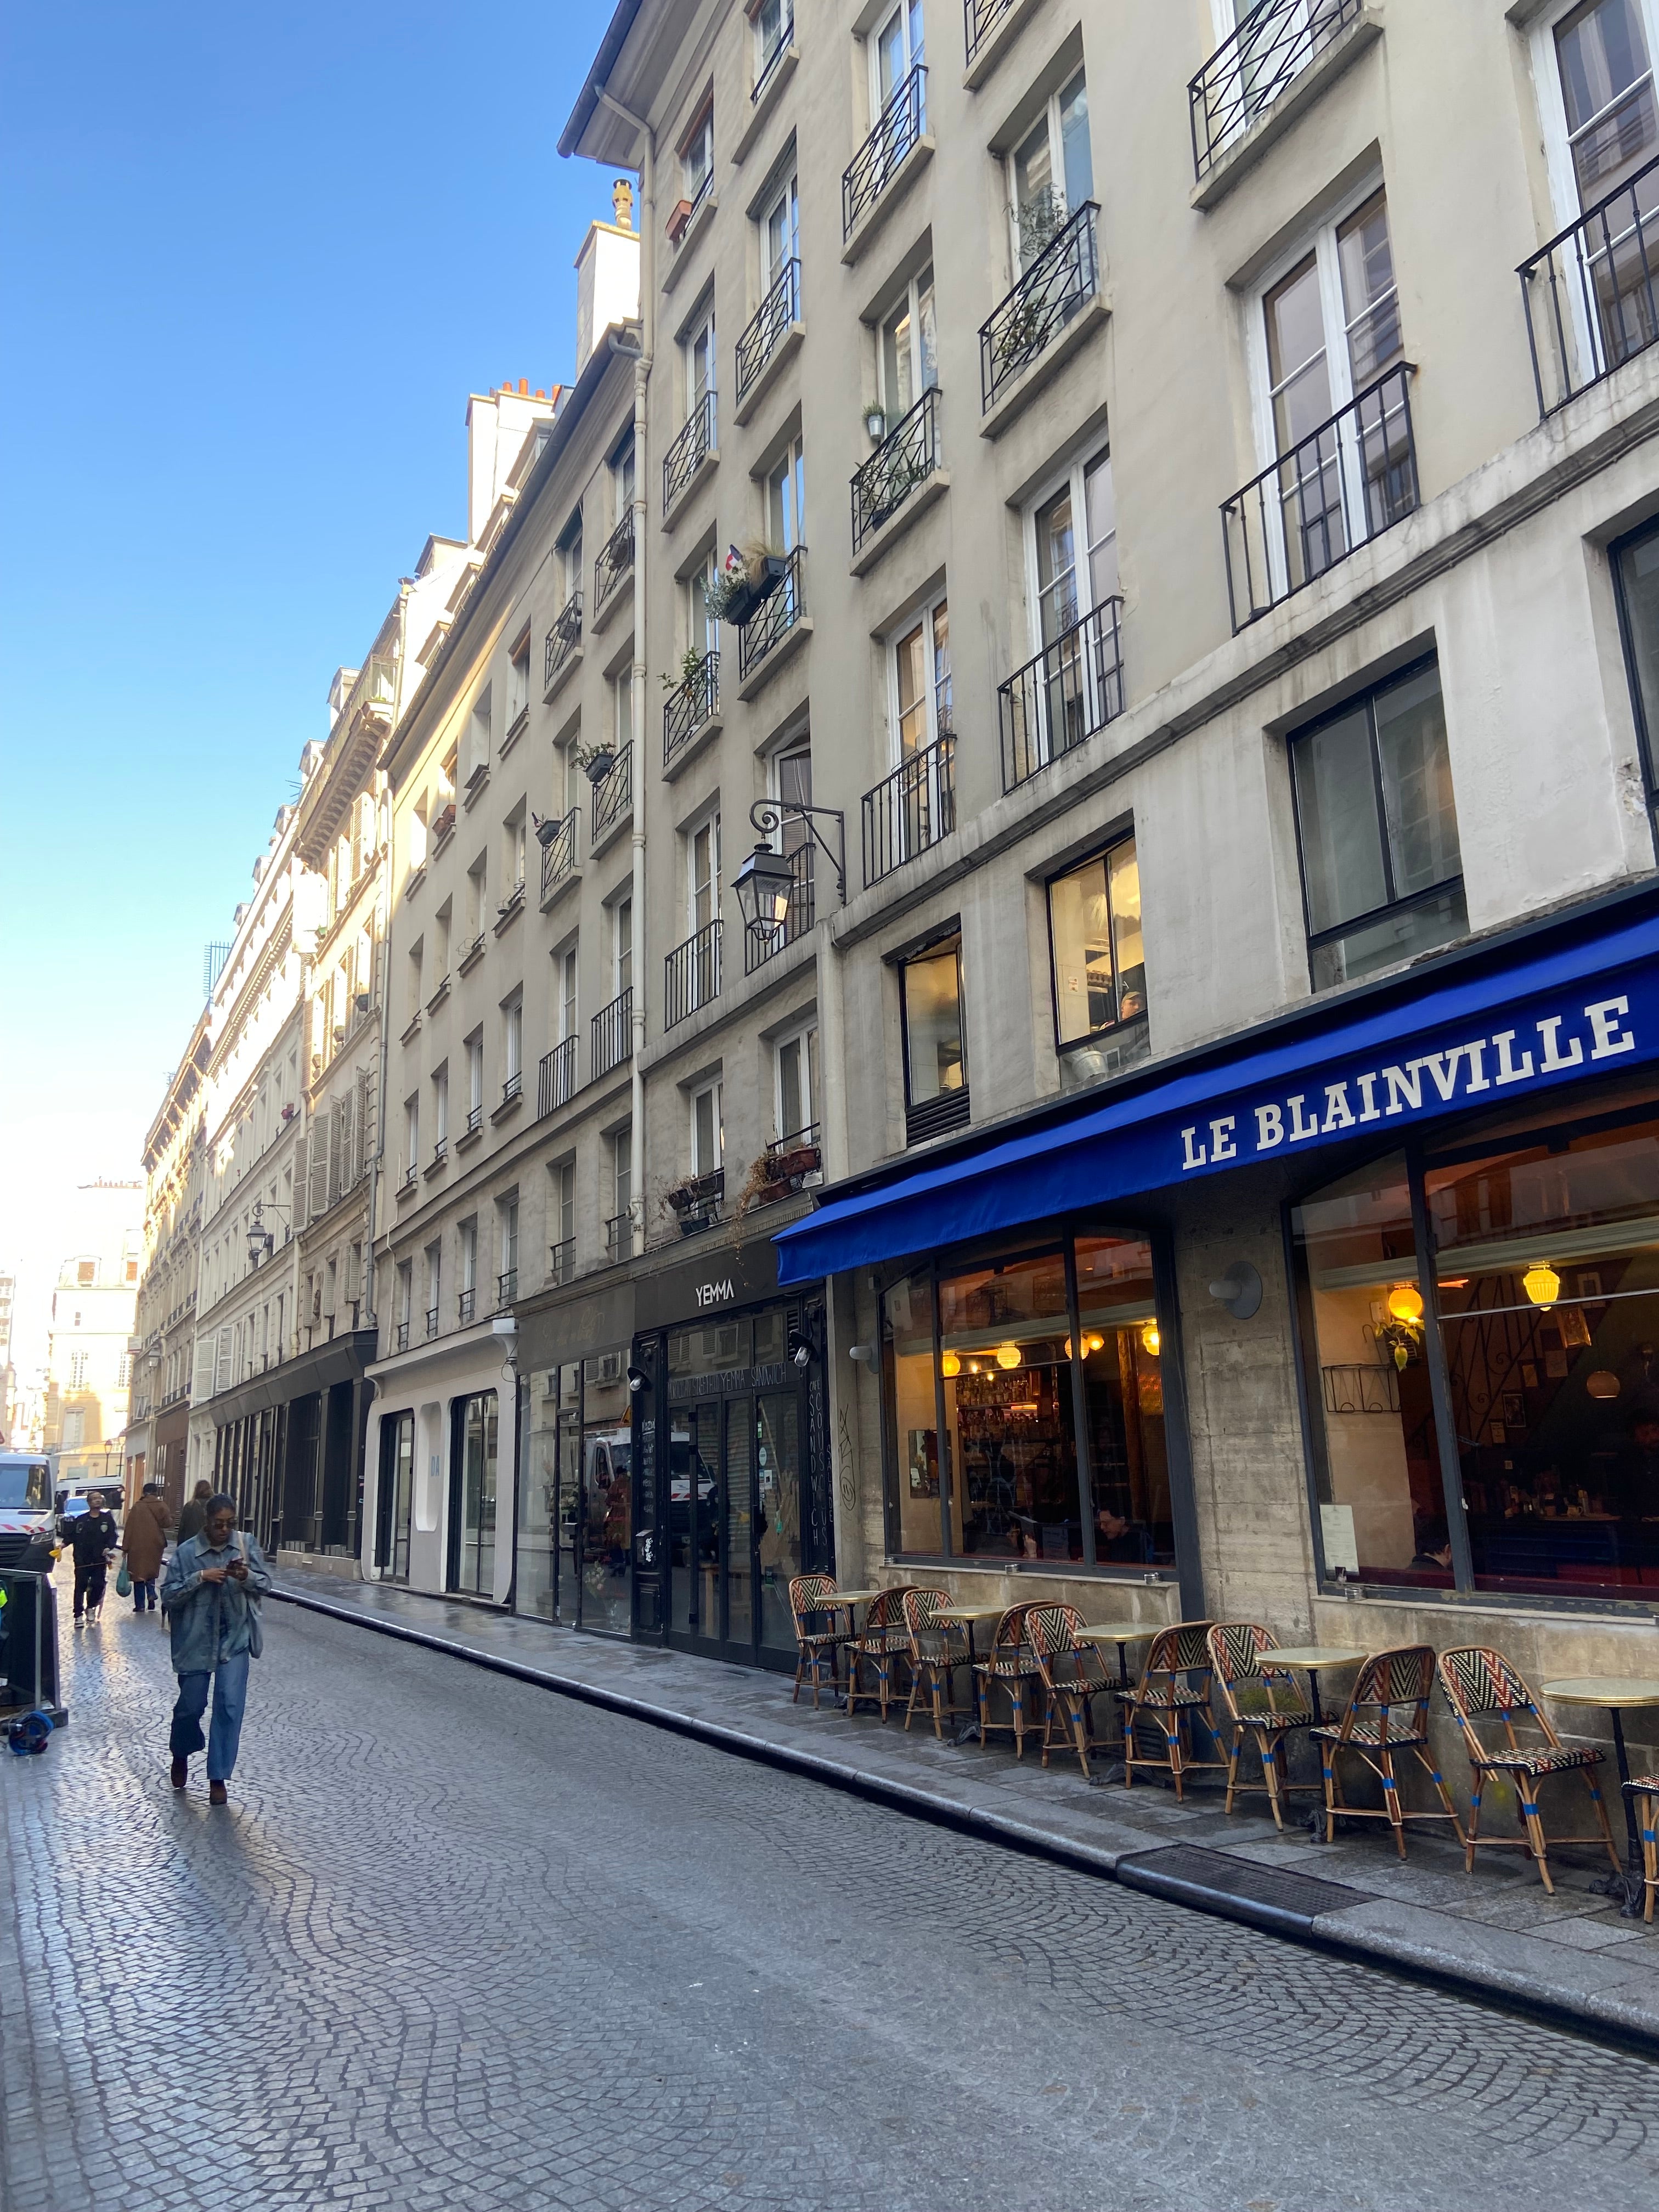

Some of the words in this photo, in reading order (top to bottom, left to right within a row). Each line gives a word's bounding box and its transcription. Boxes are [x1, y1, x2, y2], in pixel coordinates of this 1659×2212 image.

[1182, 1116, 1237, 1170] LE
[1254, 995, 1636, 1150] BLAINVILLE
[695, 1278, 735, 1307] YEMMA
[720, 1369, 746, 1391] YEMMA
[751, 1362, 786, 1387] SANDWICH
[815, 1392, 827, 1545] COUSCUS
